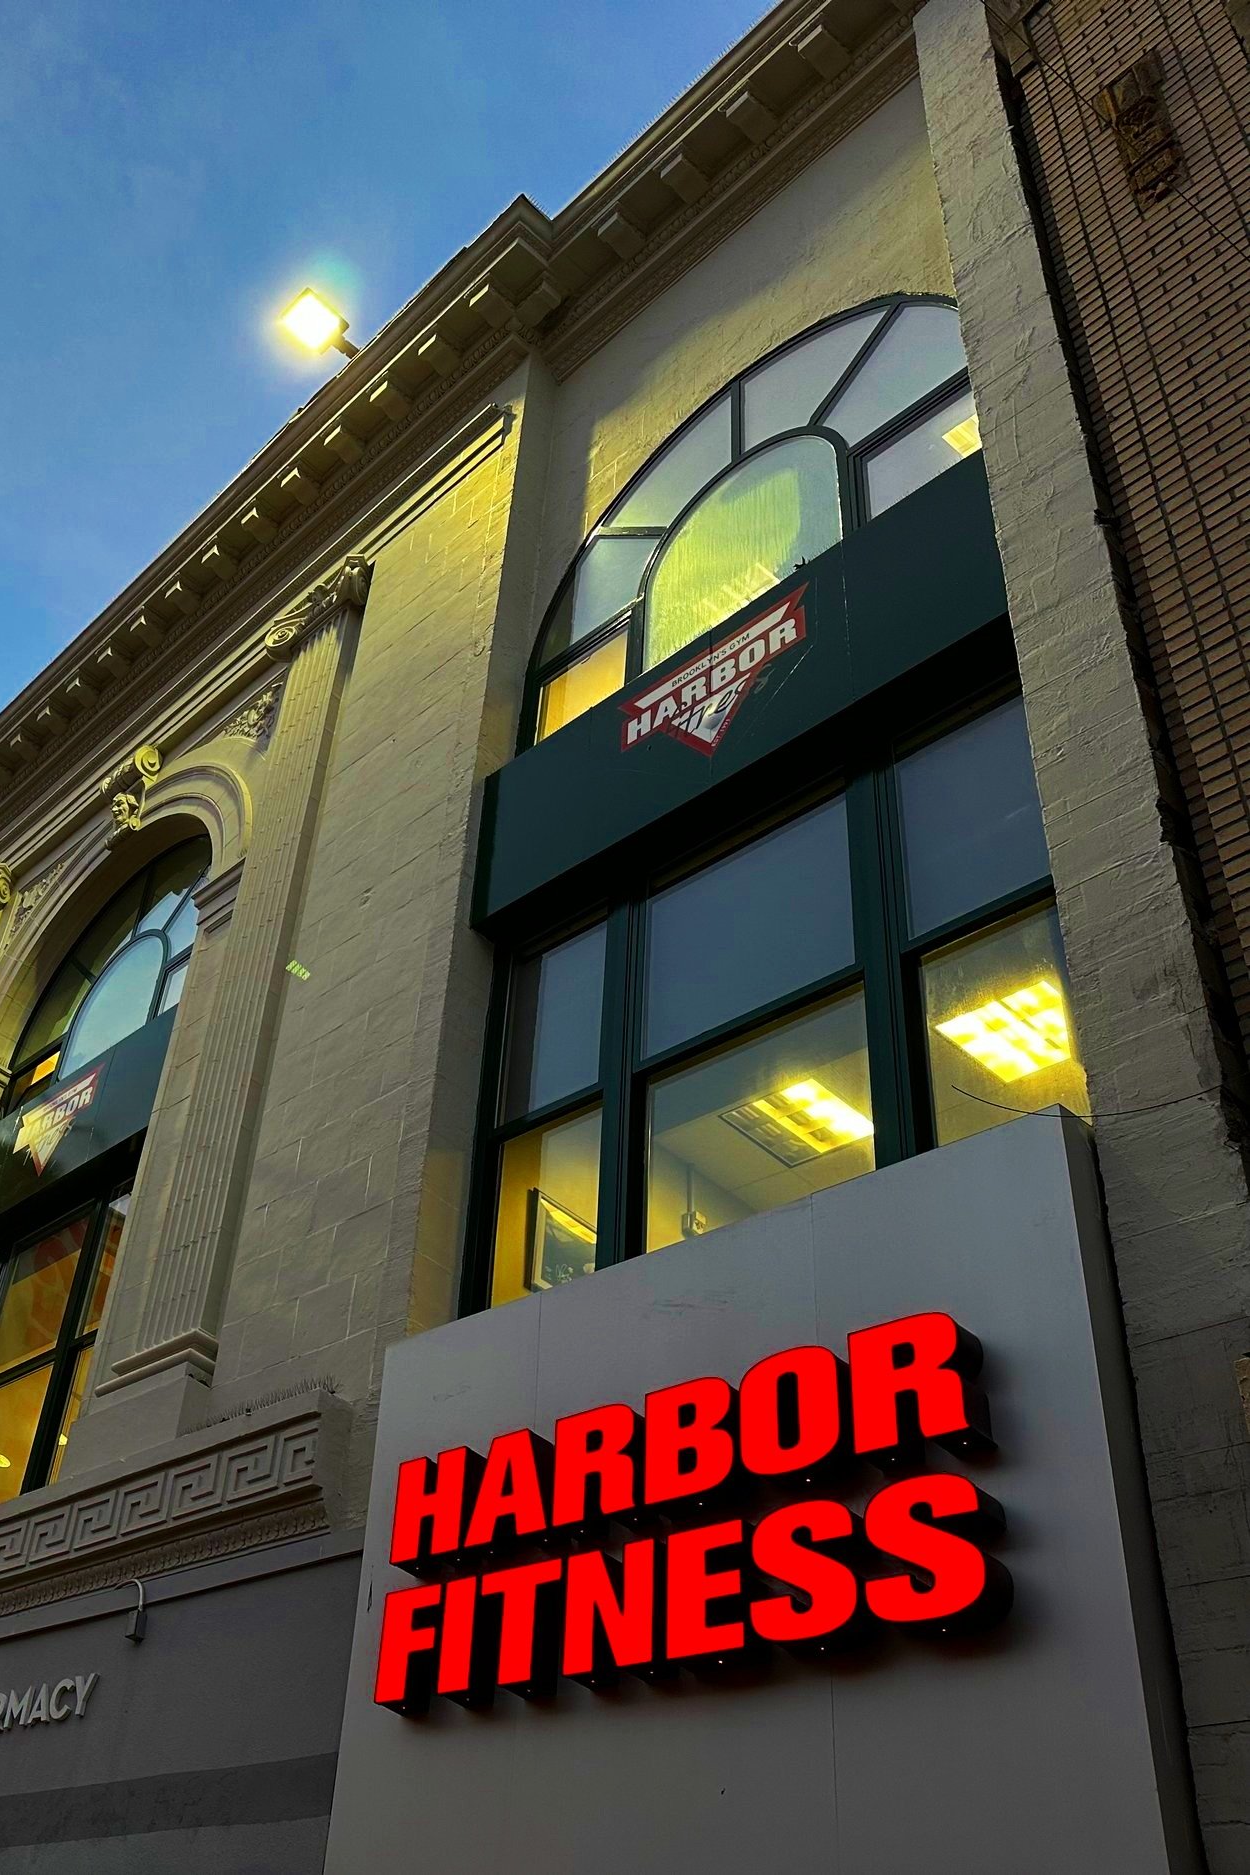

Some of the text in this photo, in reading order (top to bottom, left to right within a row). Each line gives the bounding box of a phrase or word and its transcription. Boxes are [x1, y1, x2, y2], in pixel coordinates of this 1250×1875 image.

[626, 617, 798, 745] HARBOR
[671, 632, 751, 689] BROOKLYN'S GYM
[388, 1310, 972, 1568] HARBOR
[373, 1472, 988, 1706] FITNESS
